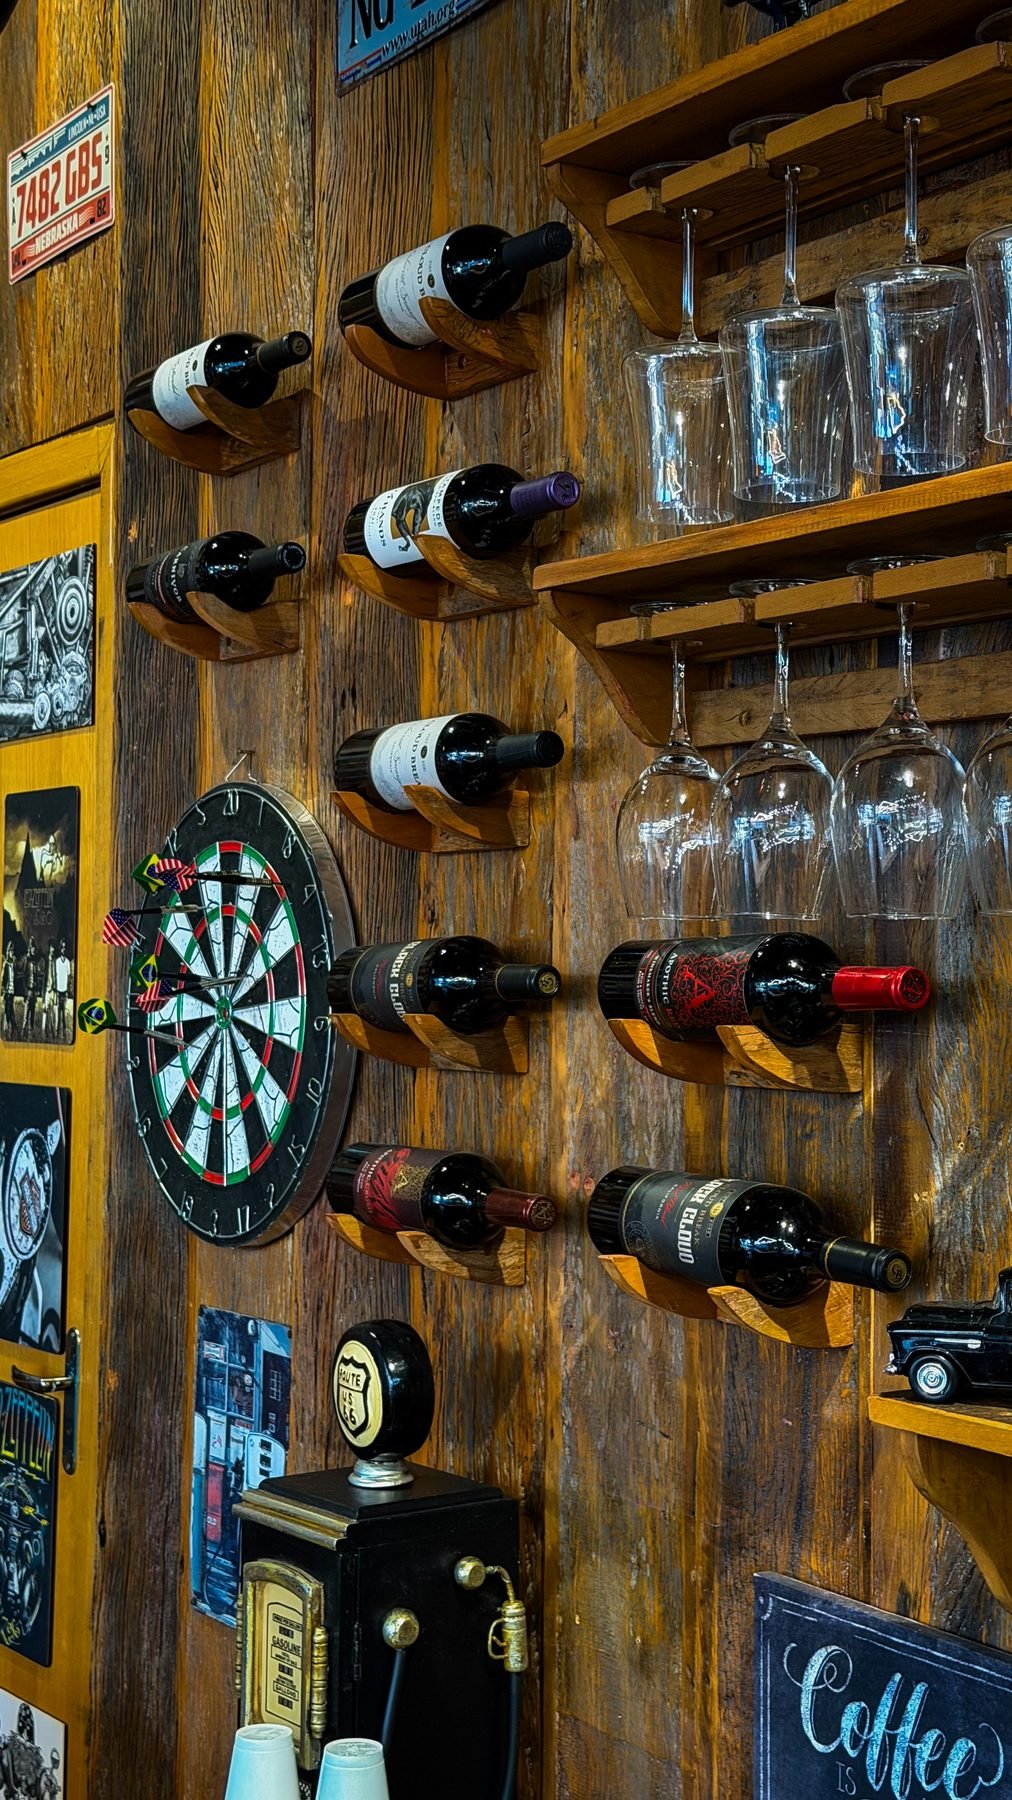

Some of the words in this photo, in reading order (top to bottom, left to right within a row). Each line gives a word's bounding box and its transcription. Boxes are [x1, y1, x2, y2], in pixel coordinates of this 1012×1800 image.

[16, 159, 61, 239] 7482
[35, 212, 79, 256] NEBRASKA
[223, 788, 240, 815] 20
[662, 952, 678, 1005] APOTHIC
[306, 1077, 321, 1110] 10
[677, 1207, 698, 1264] CLOUD
[339, 1368, 361, 1387] ROUTE
[342, 1391, 353, 1405] US
[343, 1404, 357, 1425] 66
[272, 1635, 301, 1655] GASOLINE
[276, 1684, 296, 1698] GALLONS
[783, 1642, 1004, 1800] Coffee
[836, 1761, 857, 1796] IS
